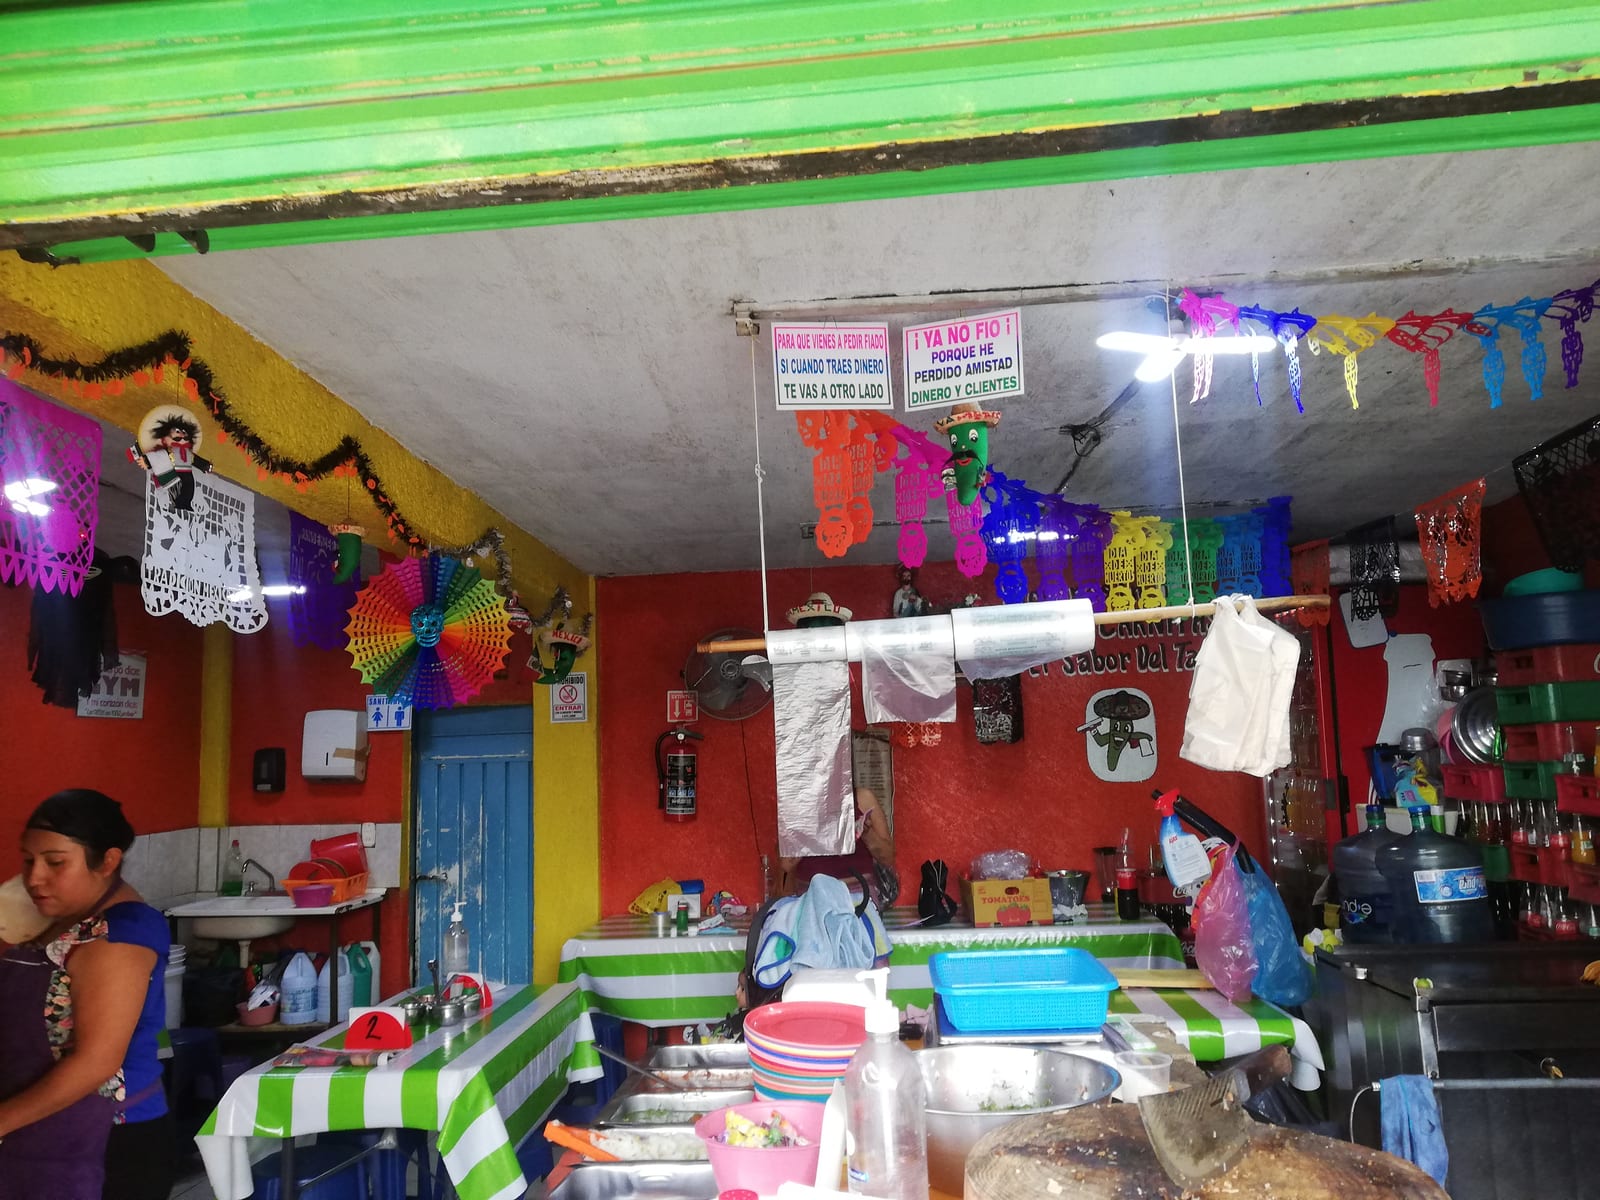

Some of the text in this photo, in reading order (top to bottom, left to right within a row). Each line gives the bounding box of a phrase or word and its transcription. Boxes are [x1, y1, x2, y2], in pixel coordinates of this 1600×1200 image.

[777, 333, 884, 349] PARA QUE VIENES A PEDIR FIADO
[923, 329, 943, 348] YA
[947, 324, 970, 345] NO
[976, 319, 1000, 340] FIO
[931, 342, 994, 364] PORQUE HE
[780, 359, 884, 374] SI CUANDO TRAES DINERO
[914, 356, 1013, 384] PERDIDO AMISTAD
[784, 383, 884, 399] TE VAS A OTRO LADO
[911, 375, 1017, 404] DINERO Y CLIENTES
[1098, 615, 1214, 640] CARNITA
[1062, 649, 1131, 677] Sabor
[1135, 643, 1169, 673] Del
[1173, 641, 1198, 672] Ta
[982, 895, 1031, 905] TOMATOES
[365, 1014, 382, 1040] 2
